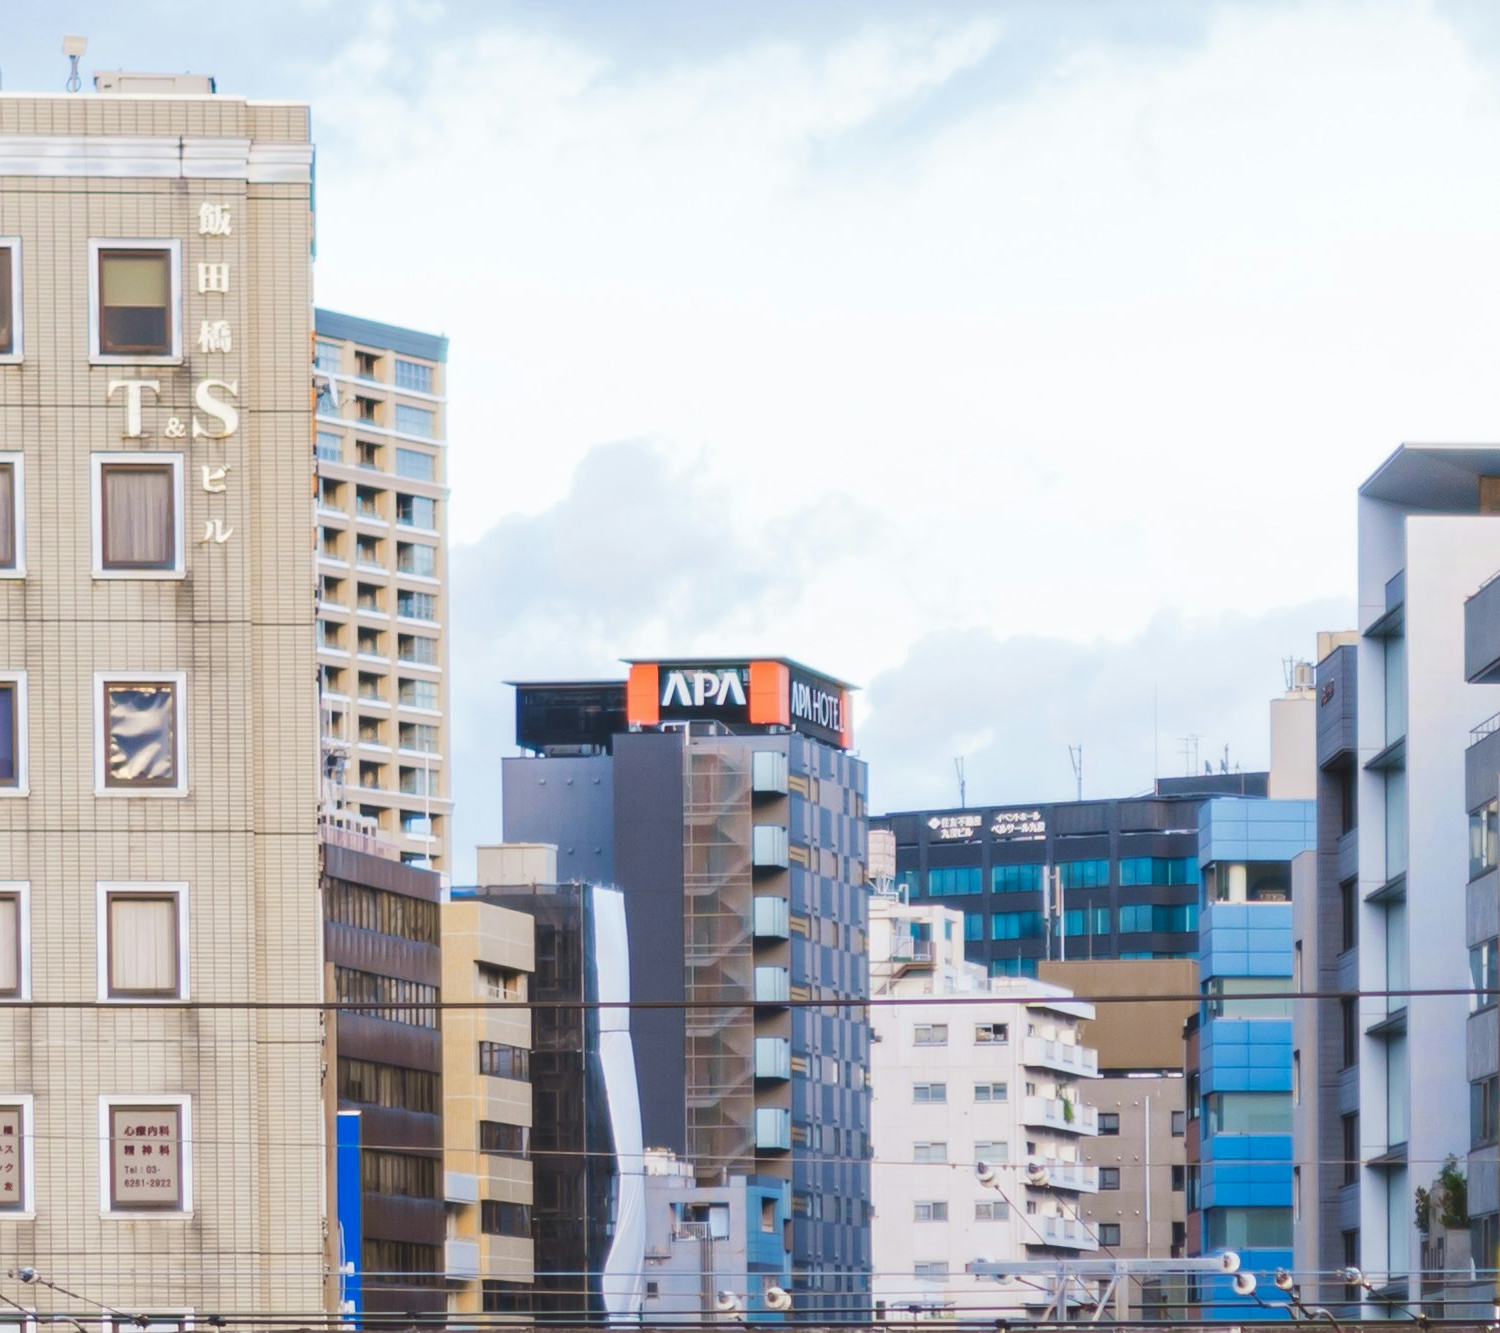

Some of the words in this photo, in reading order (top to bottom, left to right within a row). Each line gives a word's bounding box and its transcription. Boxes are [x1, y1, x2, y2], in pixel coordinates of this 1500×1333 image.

[197, 202, 233, 354] 飯田橋
[202, 463, 234, 546] ビル
[661, 671, 747, 706] APA
[791, 680, 813, 721] APA
[812, 689, 845, 733] HOTEL
